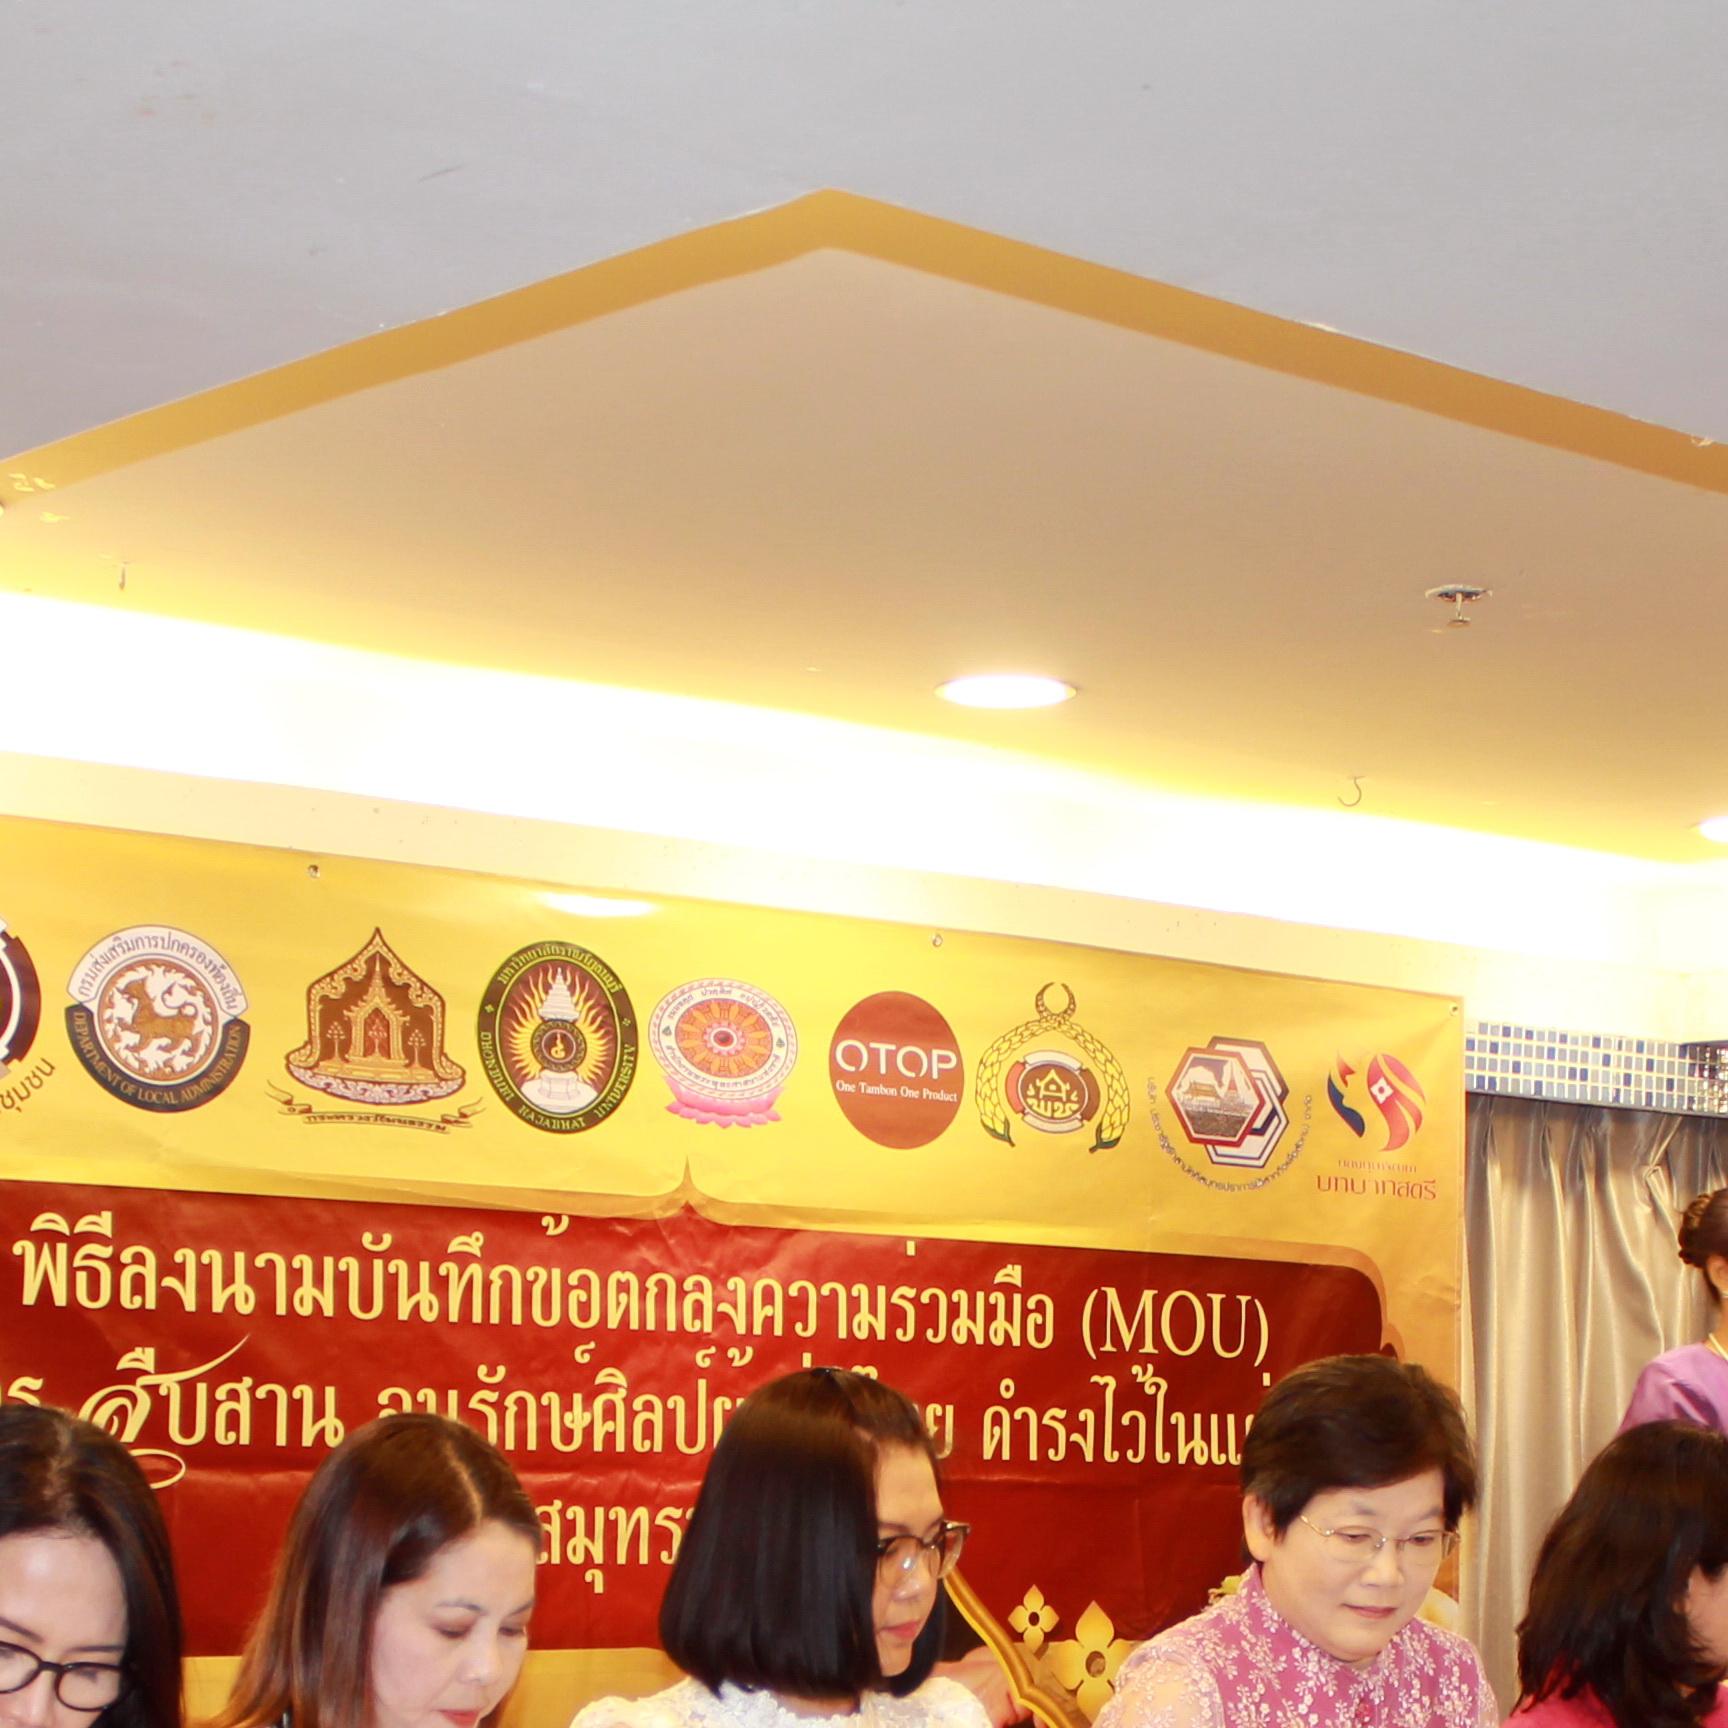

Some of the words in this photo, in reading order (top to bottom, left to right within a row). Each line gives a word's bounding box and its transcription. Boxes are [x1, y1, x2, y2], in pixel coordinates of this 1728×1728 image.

[74, 1011, 123, 1087] DEPARTMENT
[120, 1081, 137, 1097] OF
[137, 1087, 179, 1104] LOCAL
[180, 1025, 243, 1103] ADMINISTRATION
[518, 1104, 587, 1131] RAJABHAT
[593, 1043, 636, 1119] UNIVERSITY
[835, 1039, 957, 1080] OTOP
[835, 1079, 856, 1093] One
[858, 1082, 898, 1097] Tambon
[899, 1085, 920, 1099] One
[922, 1088, 958, 1103] Product
[12, 1210, 1055, 1349] พิธีลงนามบันทึกข้อตกลงความร่วมมือ
[1082, 1286, 1270, 1367] (MOU)
[534, 1499, 695, 1594] สมุทร
